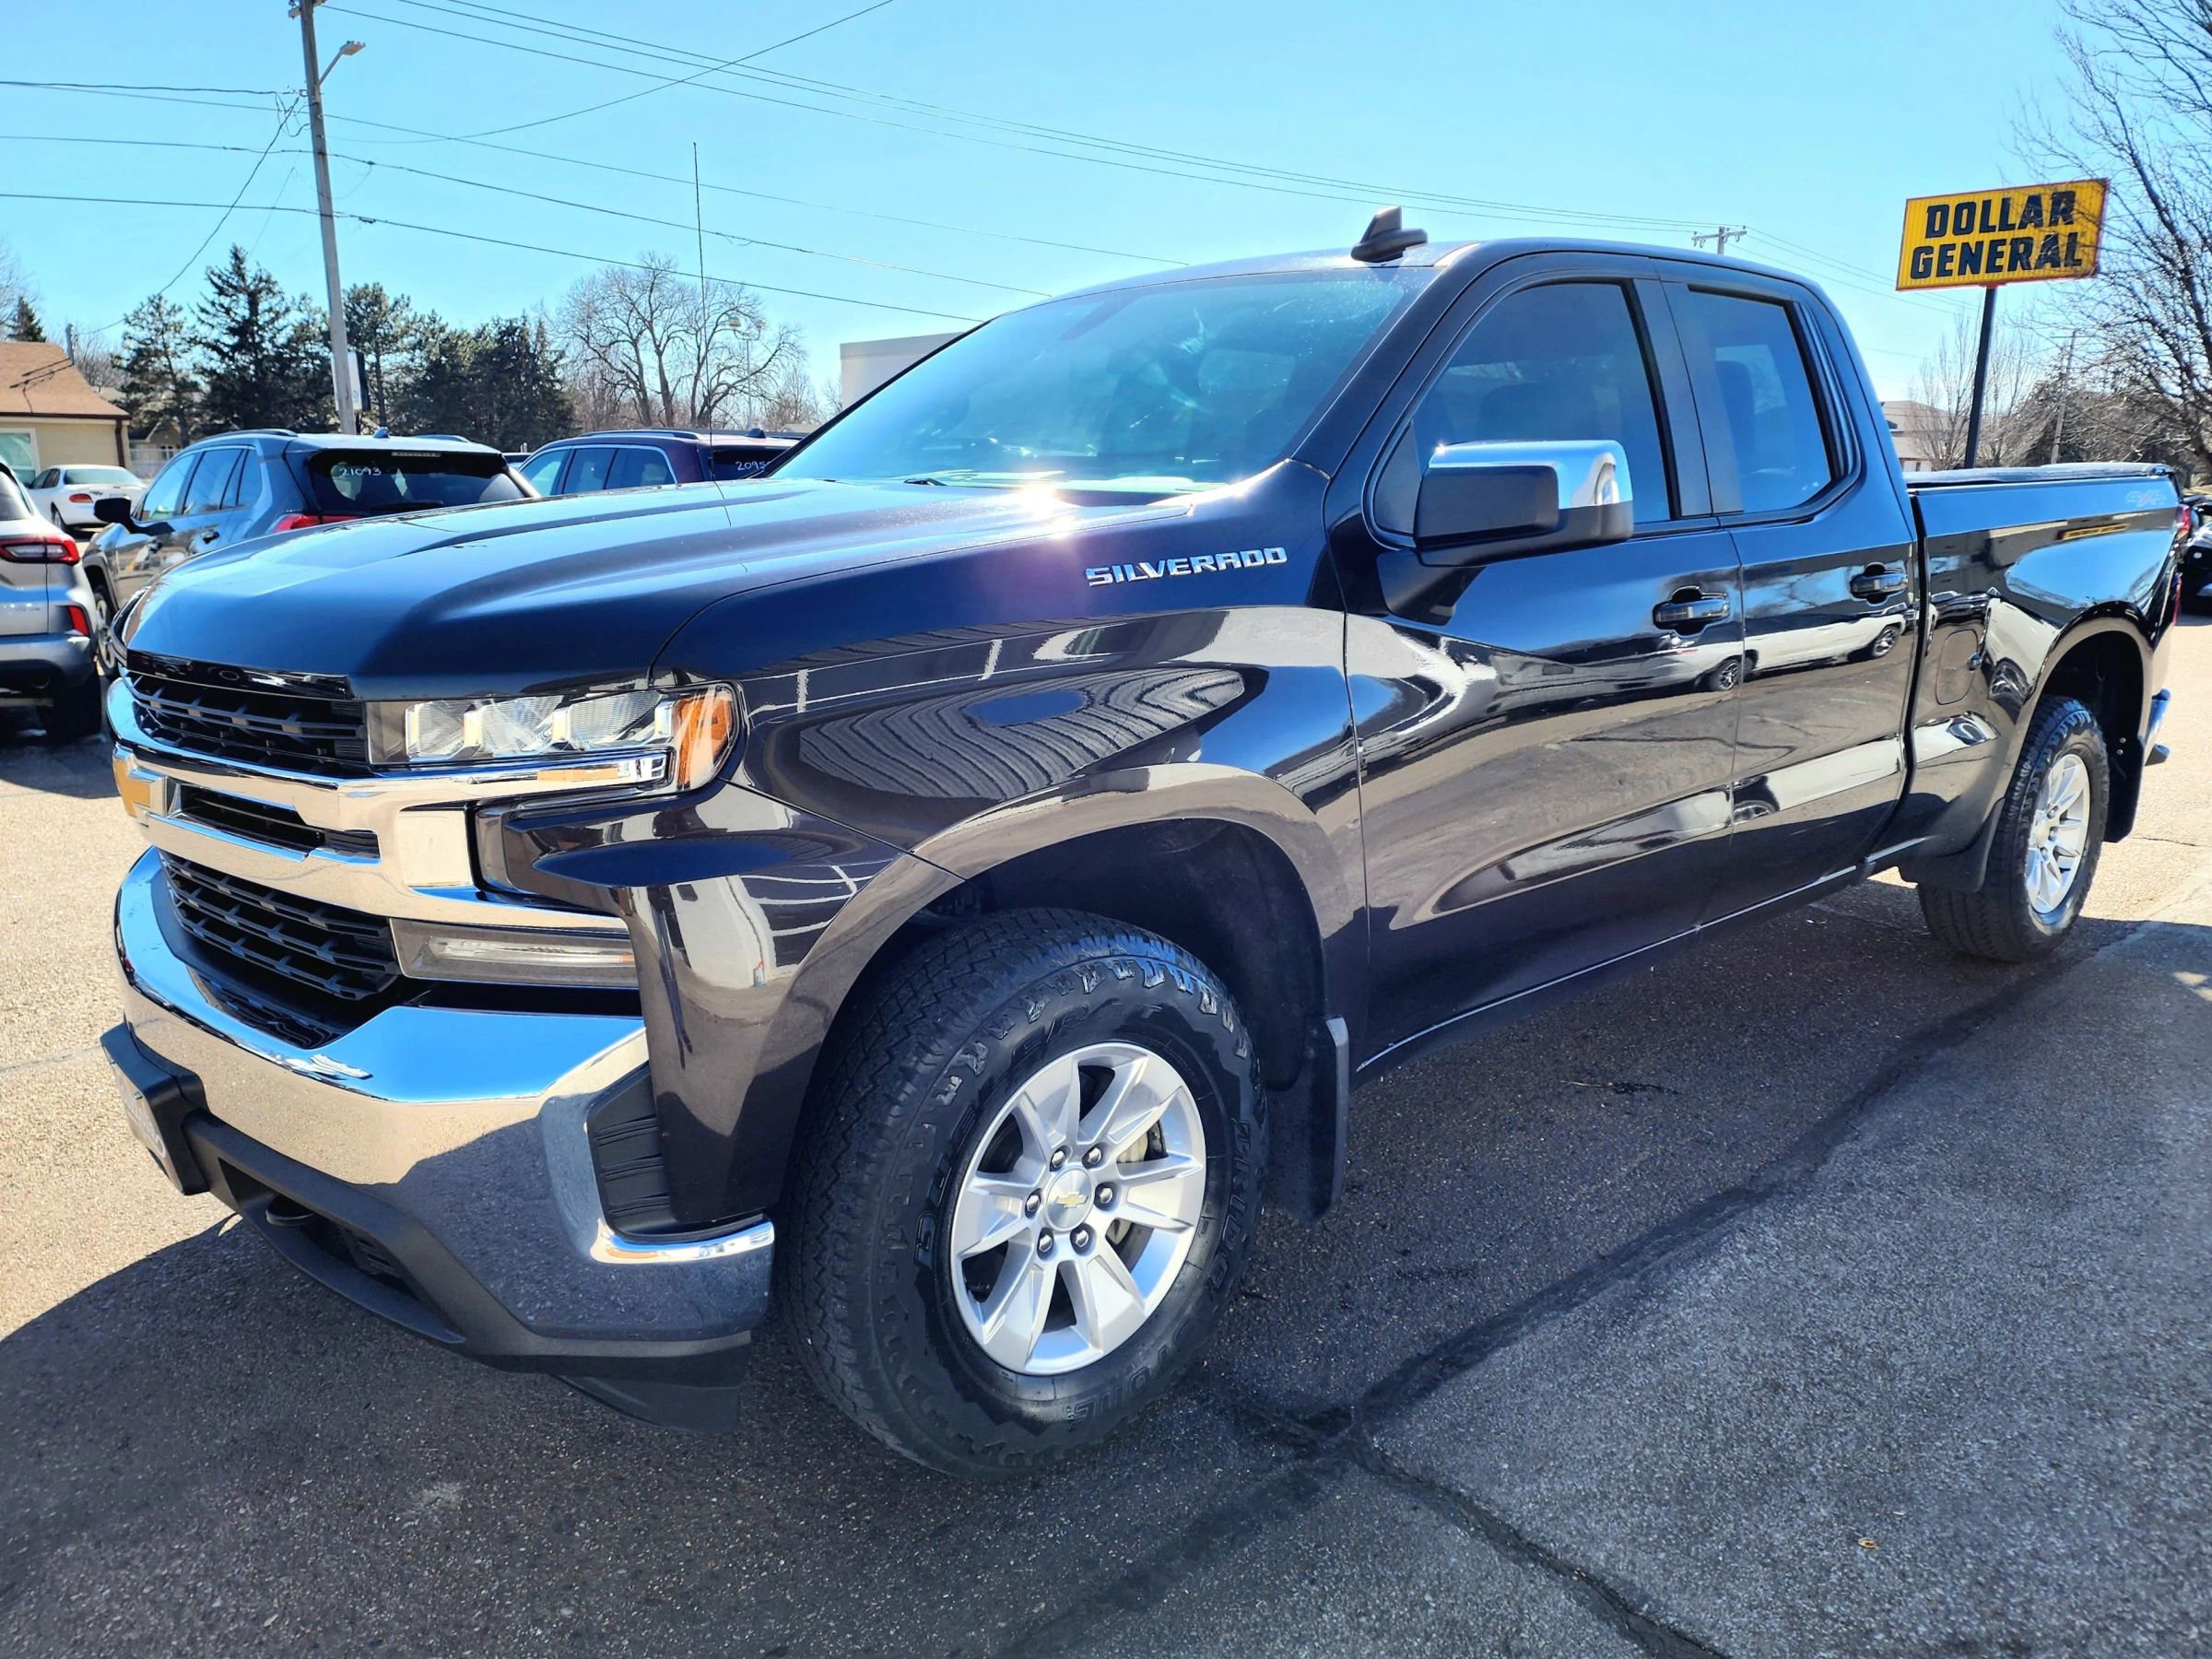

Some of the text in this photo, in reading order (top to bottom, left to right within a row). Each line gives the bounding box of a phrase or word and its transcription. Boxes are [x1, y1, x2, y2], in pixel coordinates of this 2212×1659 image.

[1925, 191, 2076, 239] DOLLAR
[1910, 231, 2082, 279] GENERAL
[338, 466, 382, 476] 21093
[1085, 547, 1288, 587] SILVERADO
